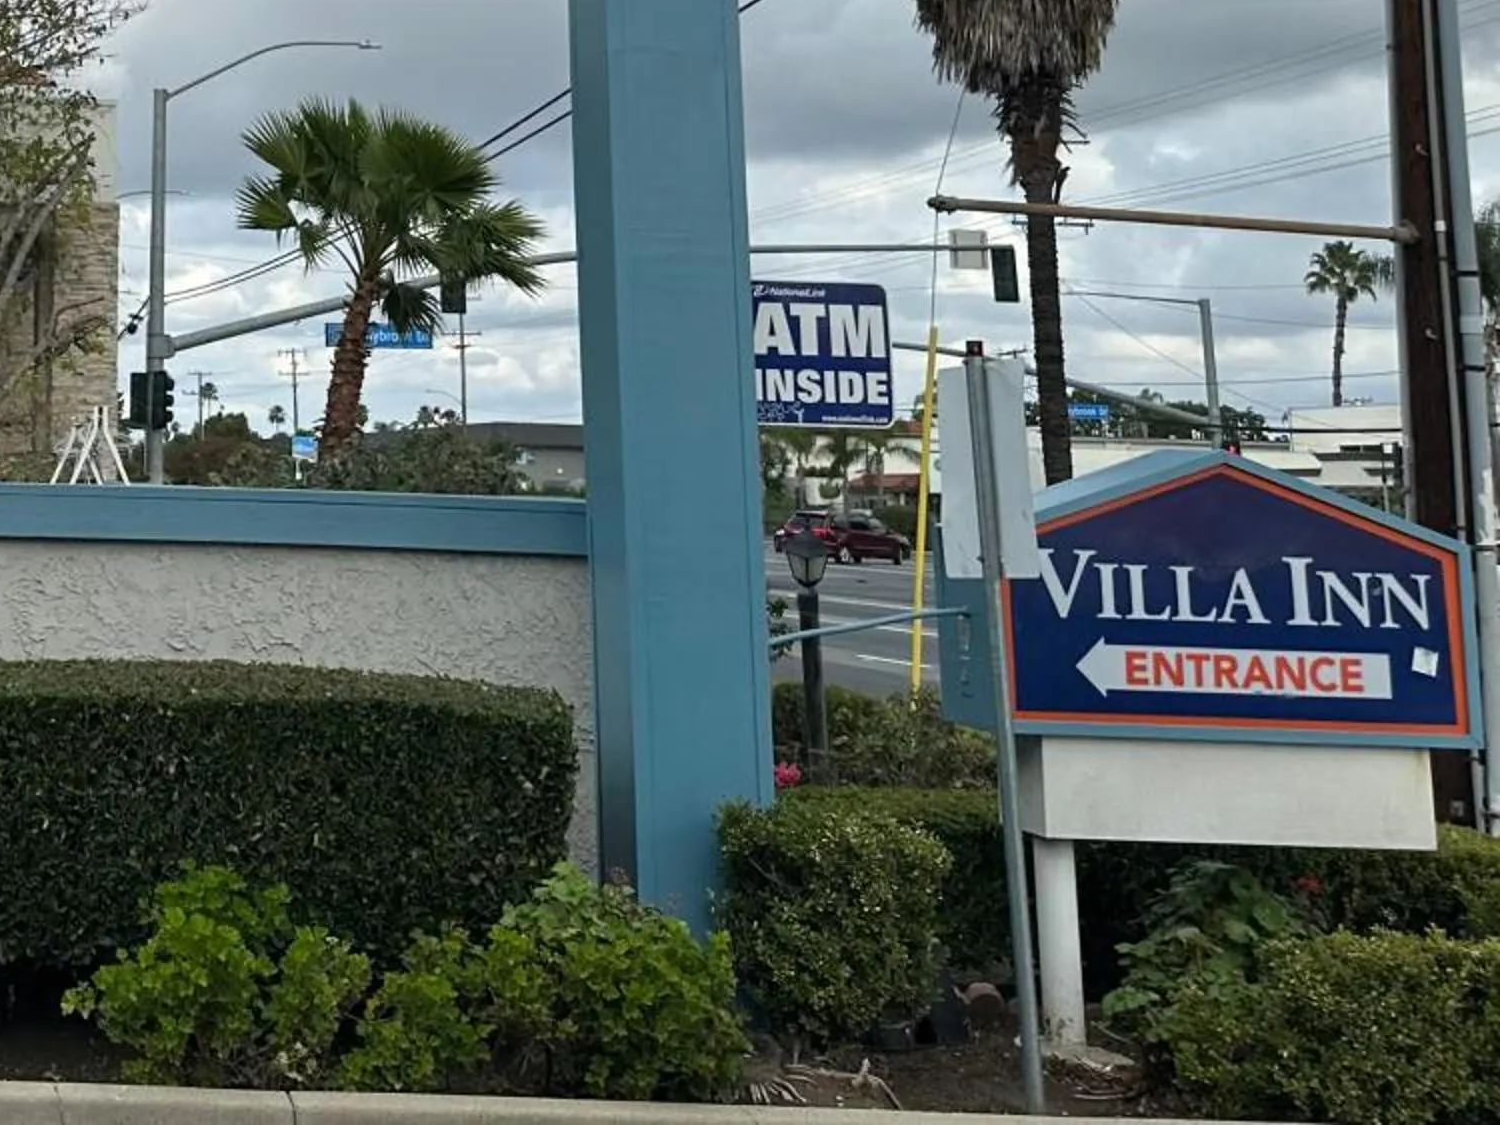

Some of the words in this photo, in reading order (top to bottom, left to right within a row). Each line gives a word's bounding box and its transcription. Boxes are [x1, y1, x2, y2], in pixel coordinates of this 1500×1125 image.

[754, 302, 887, 358] ATM
[754, 368, 889, 405] INSIDE
[1038, 548, 1270, 625] VILLA
[1281, 556, 1432, 631] INN
[1124, 650, 1365, 693] ENTRANCE
